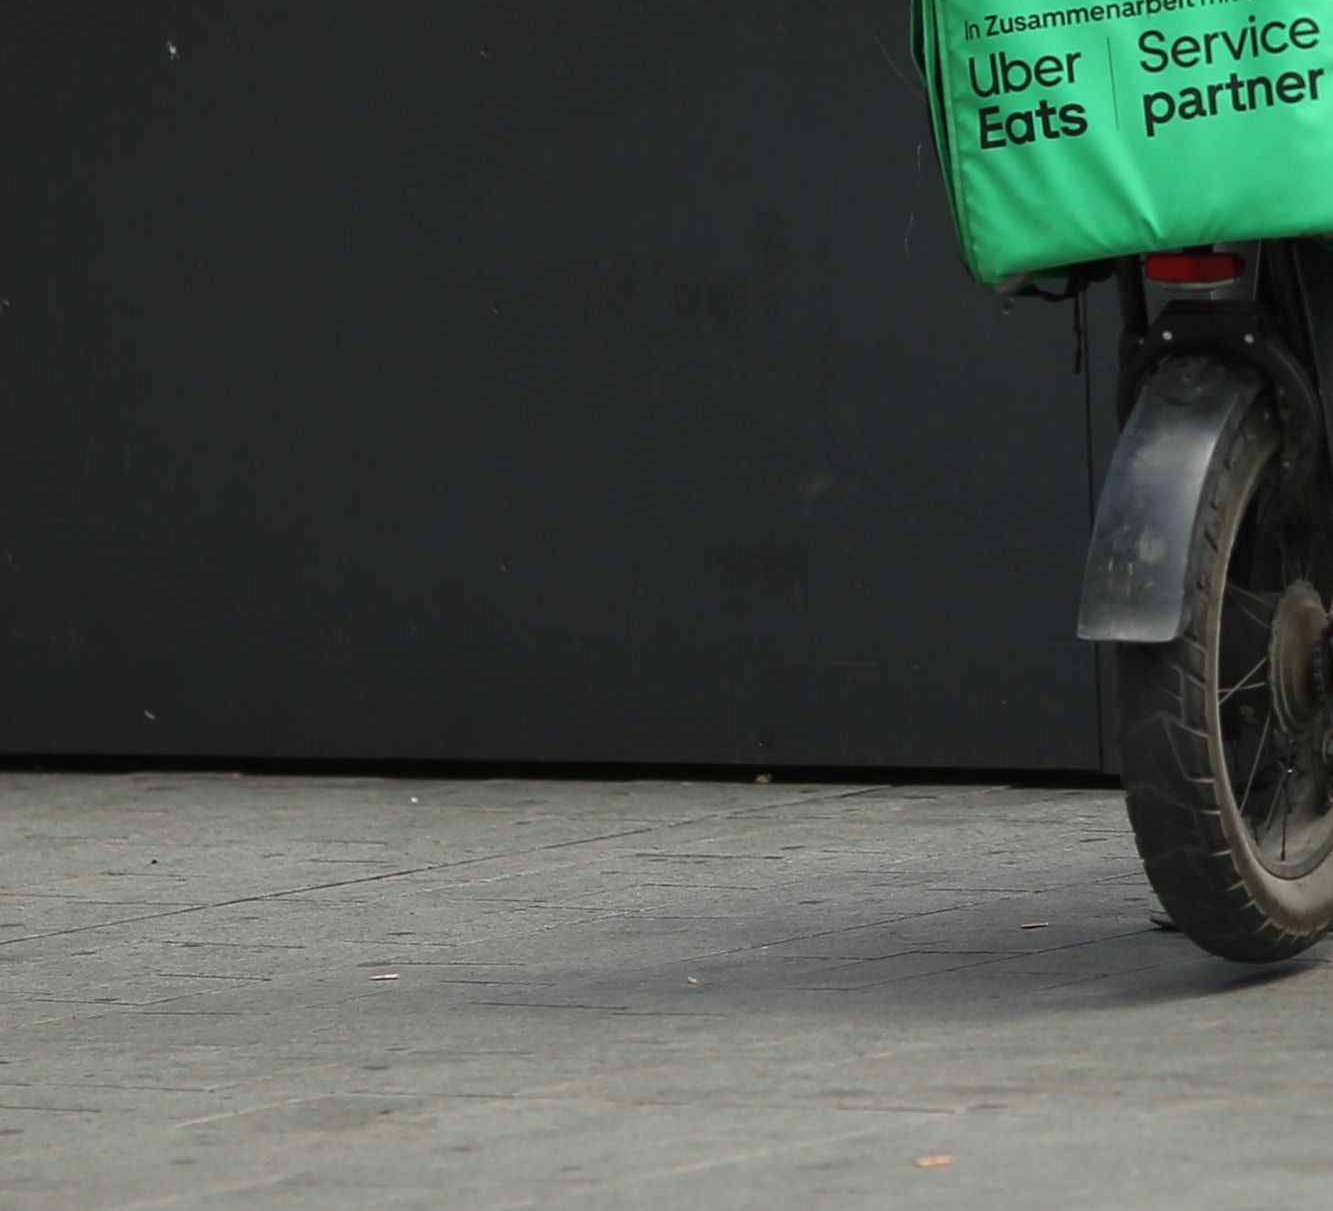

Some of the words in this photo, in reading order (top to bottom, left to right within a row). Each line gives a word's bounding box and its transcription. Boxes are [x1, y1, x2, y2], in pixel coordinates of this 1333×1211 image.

[964, 20, 981, 41] In
[1138, 15, 1320, 73] Service
[969, 51, 1082, 98] Uber
[978, 99, 1088, 150] Eats
[1143, 68, 1324, 137] partner
